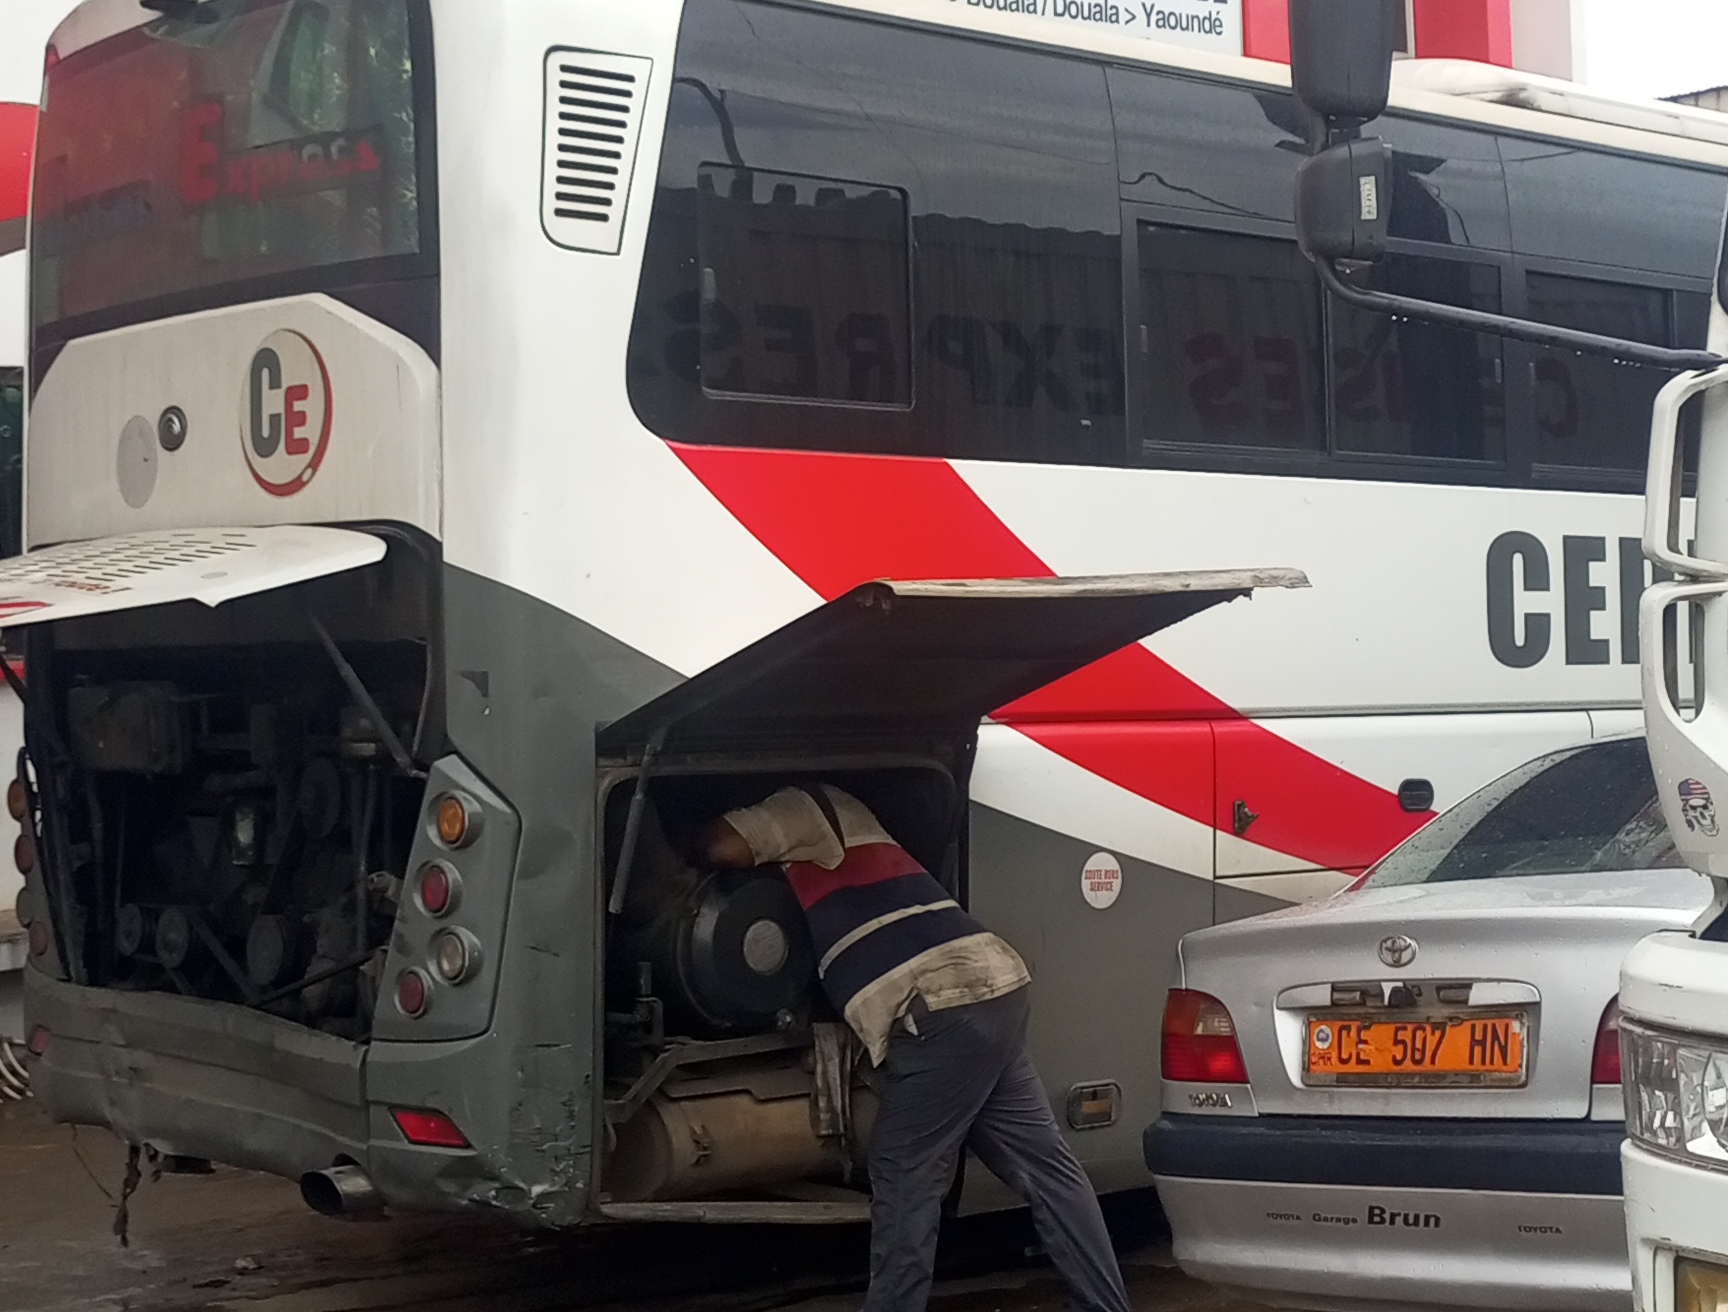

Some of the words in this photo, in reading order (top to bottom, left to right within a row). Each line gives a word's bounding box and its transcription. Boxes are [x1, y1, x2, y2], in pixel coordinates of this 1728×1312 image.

[1141, 2, 1223, 35] Yaoundé
[250, 346, 311, 458] CE
[1338, 1024, 1371, 1066] CE
[1392, 1023, 1446, 1066] 507
[1468, 1023, 1509, 1066] HN
[1312, 1213, 1358, 1226] Garage
[1367, 1205, 1441, 1228] Brun
